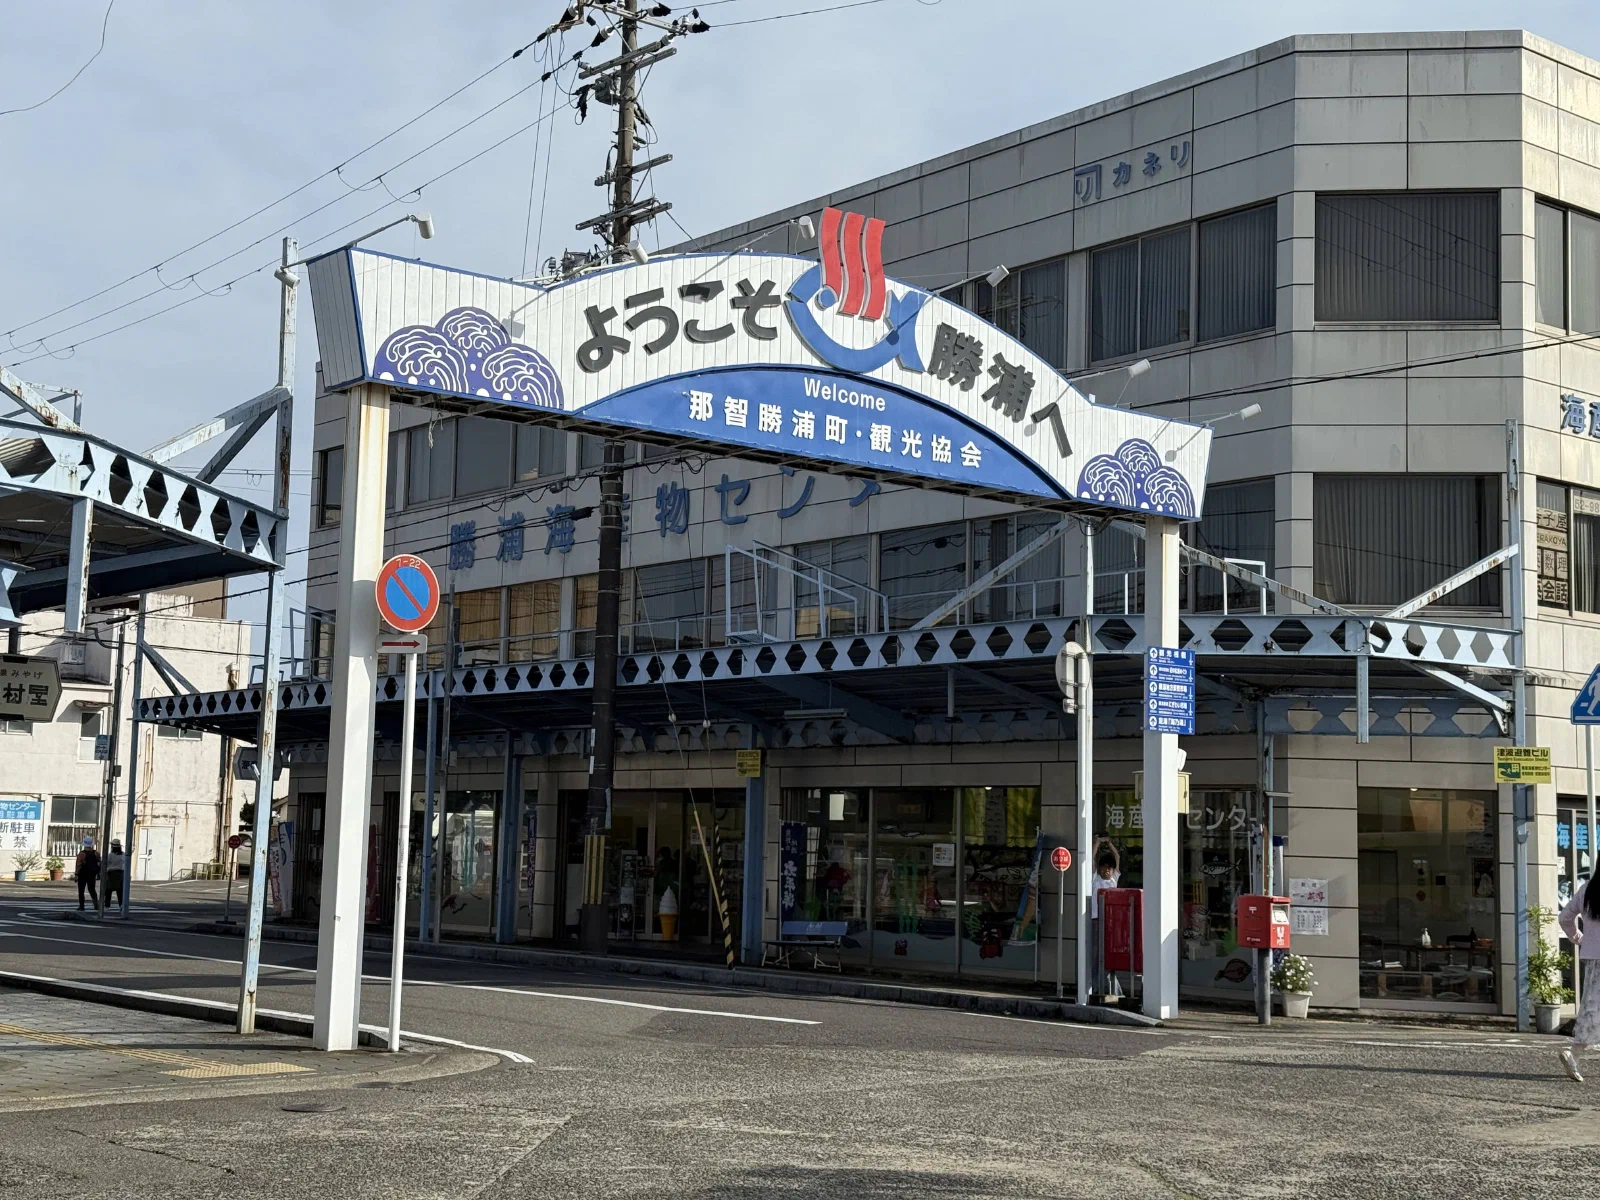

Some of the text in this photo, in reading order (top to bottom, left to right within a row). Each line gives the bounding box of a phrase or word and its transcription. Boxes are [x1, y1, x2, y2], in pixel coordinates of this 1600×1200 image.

[576, 278, 1074, 459] ようこそ 勝浦へ
[803, 376, 886, 412] Welcome
[689, 389, 982, 469] 那智勝浦町・観光協会
[0, 835, 28, 848] 禁
